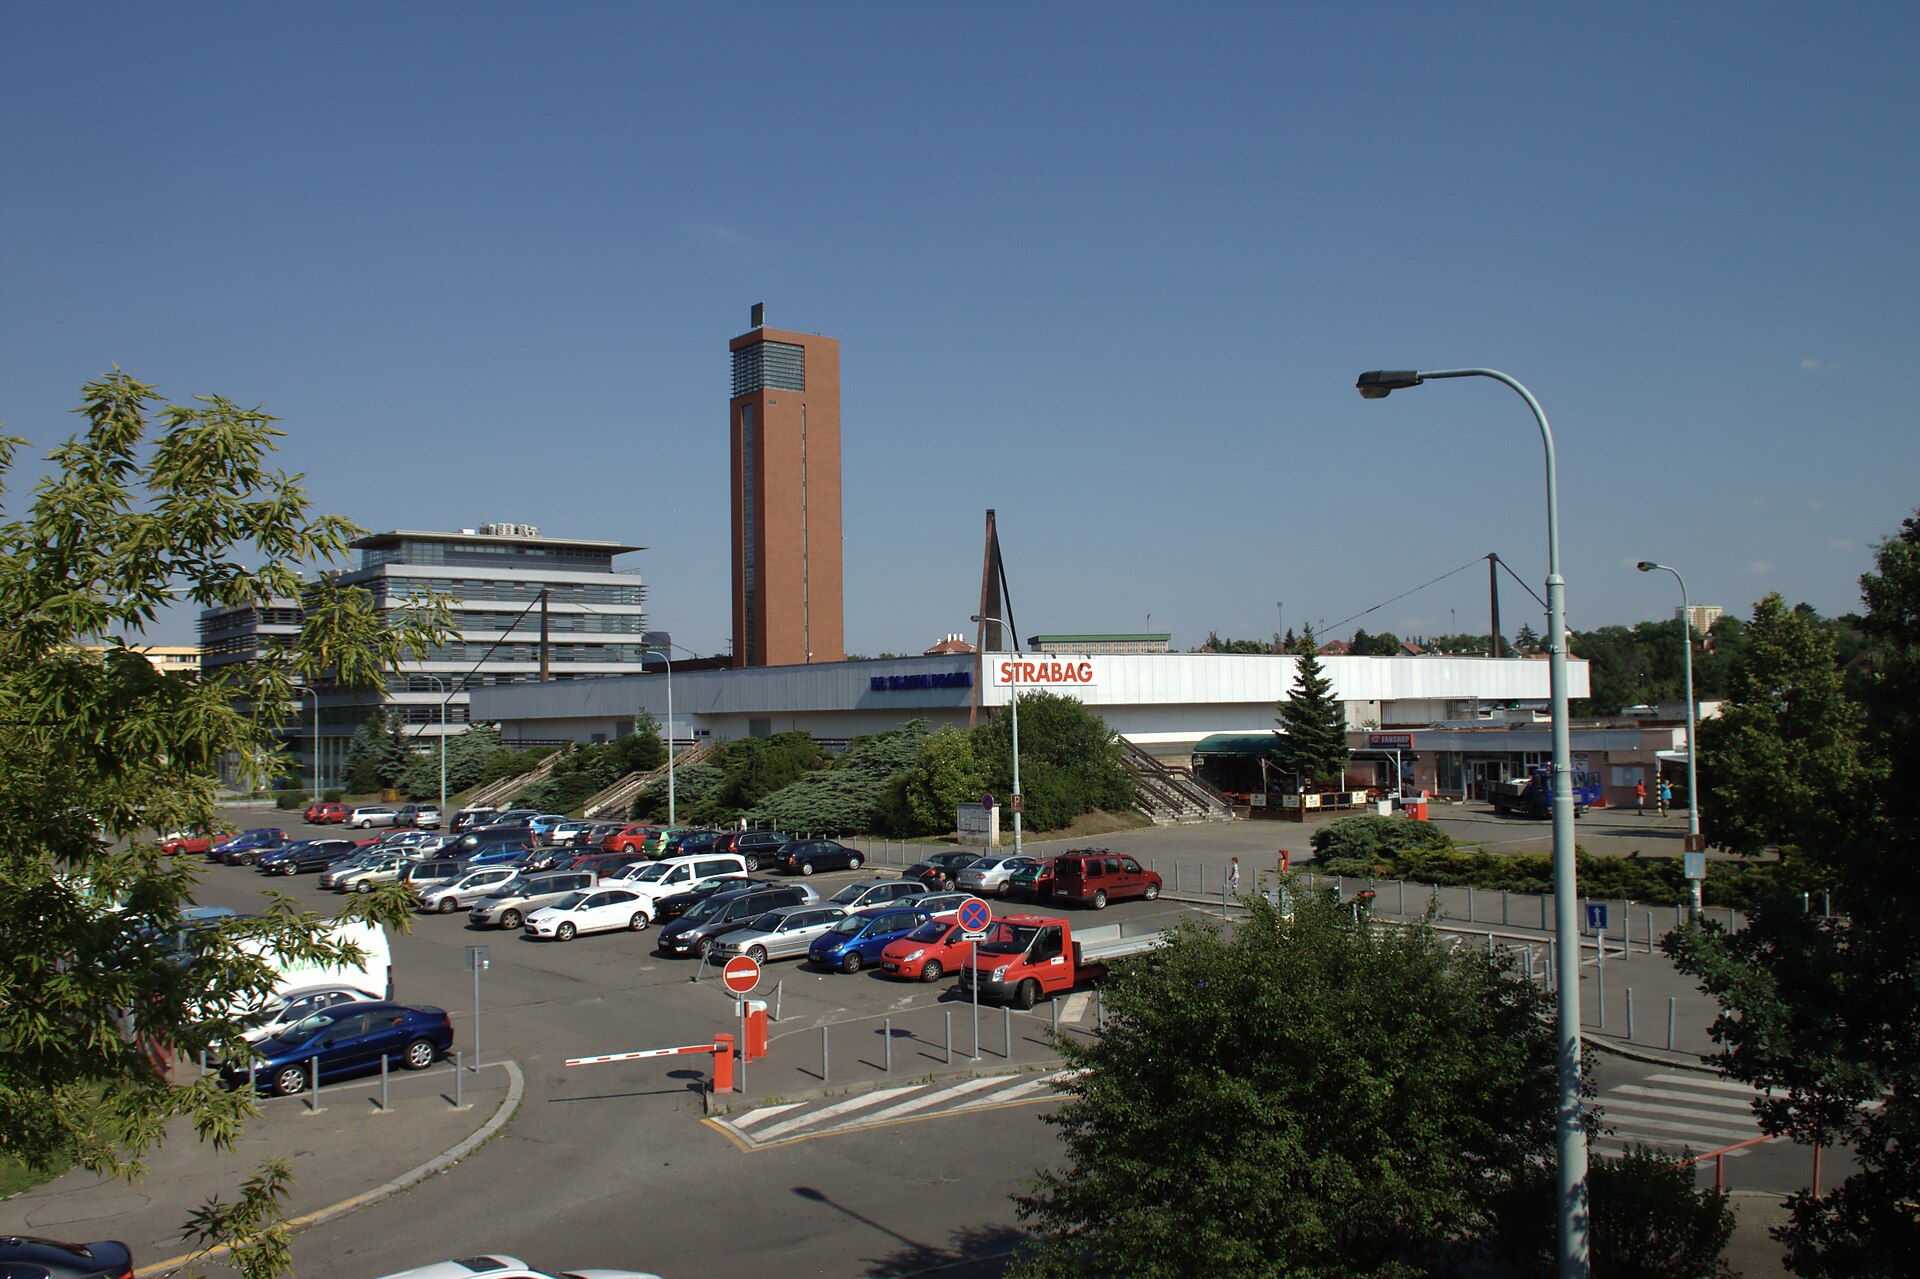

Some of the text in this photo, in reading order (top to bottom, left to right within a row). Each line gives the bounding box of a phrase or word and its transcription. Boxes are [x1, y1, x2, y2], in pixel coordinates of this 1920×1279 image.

[1001, 662, 1093, 683] STRABAG
[1381, 735, 1410, 743] FANSHOP
[1014, 796, 1020, 806] P
